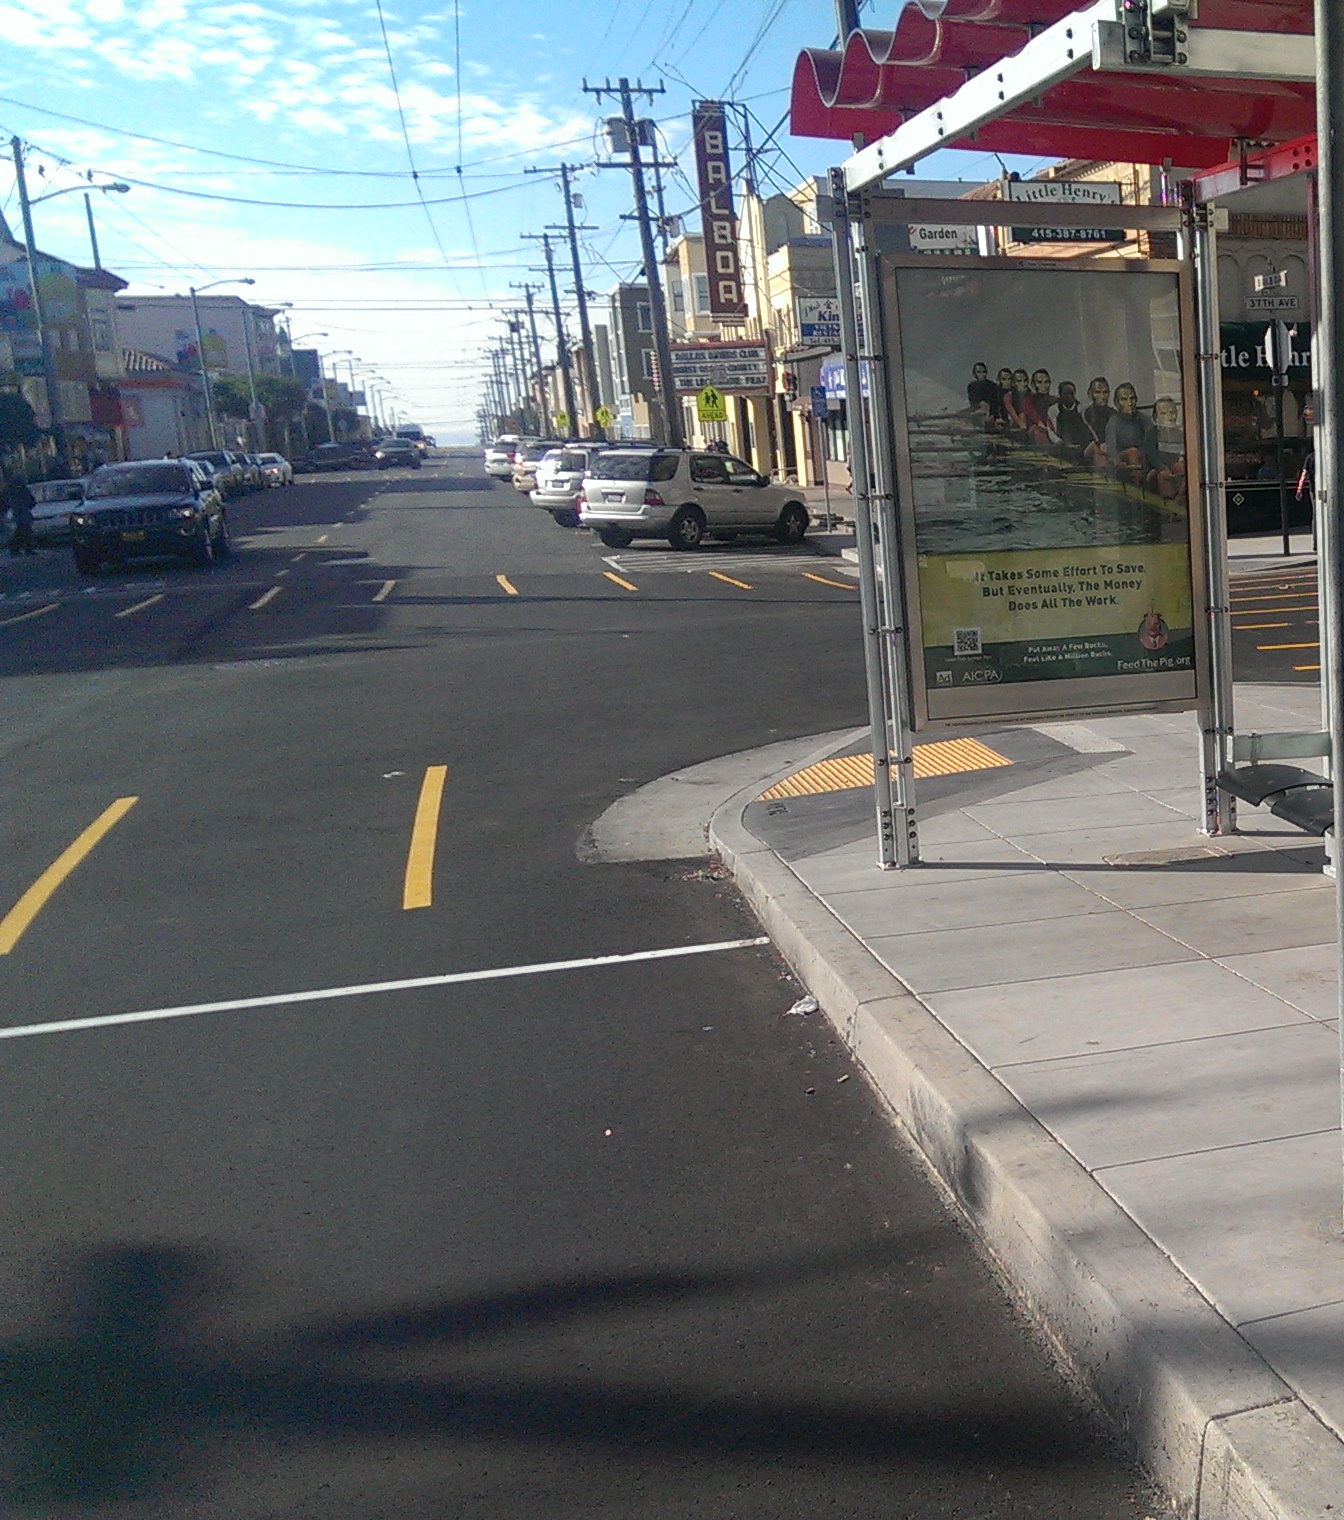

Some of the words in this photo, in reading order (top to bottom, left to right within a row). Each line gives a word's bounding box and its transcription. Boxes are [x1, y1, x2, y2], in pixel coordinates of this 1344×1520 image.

[704, 130, 739, 304] BALBOA
[918, 227, 958, 240] Garden
[1249, 299, 1275, 308] 37TH
[1278, 298, 1296, 307] AVE
[988, 569, 1024, 582] Takes
[1026, 568, 1060, 579] Some
[1062, 565, 1098, 577] Effort
[1100, 564, 1114, 575] To
[982, 586, 1005, 598] But
[1007, 582, 1077, 597] Eventually,
[1077, 580, 1100, 592] The
[1103, 578, 1143, 591] Money
[1008, 600, 1039, 612] Does
[1041, 598, 1059, 609] All
[1060, 597, 1083, 608] The
[1085, 594, 1119, 606] Work.
